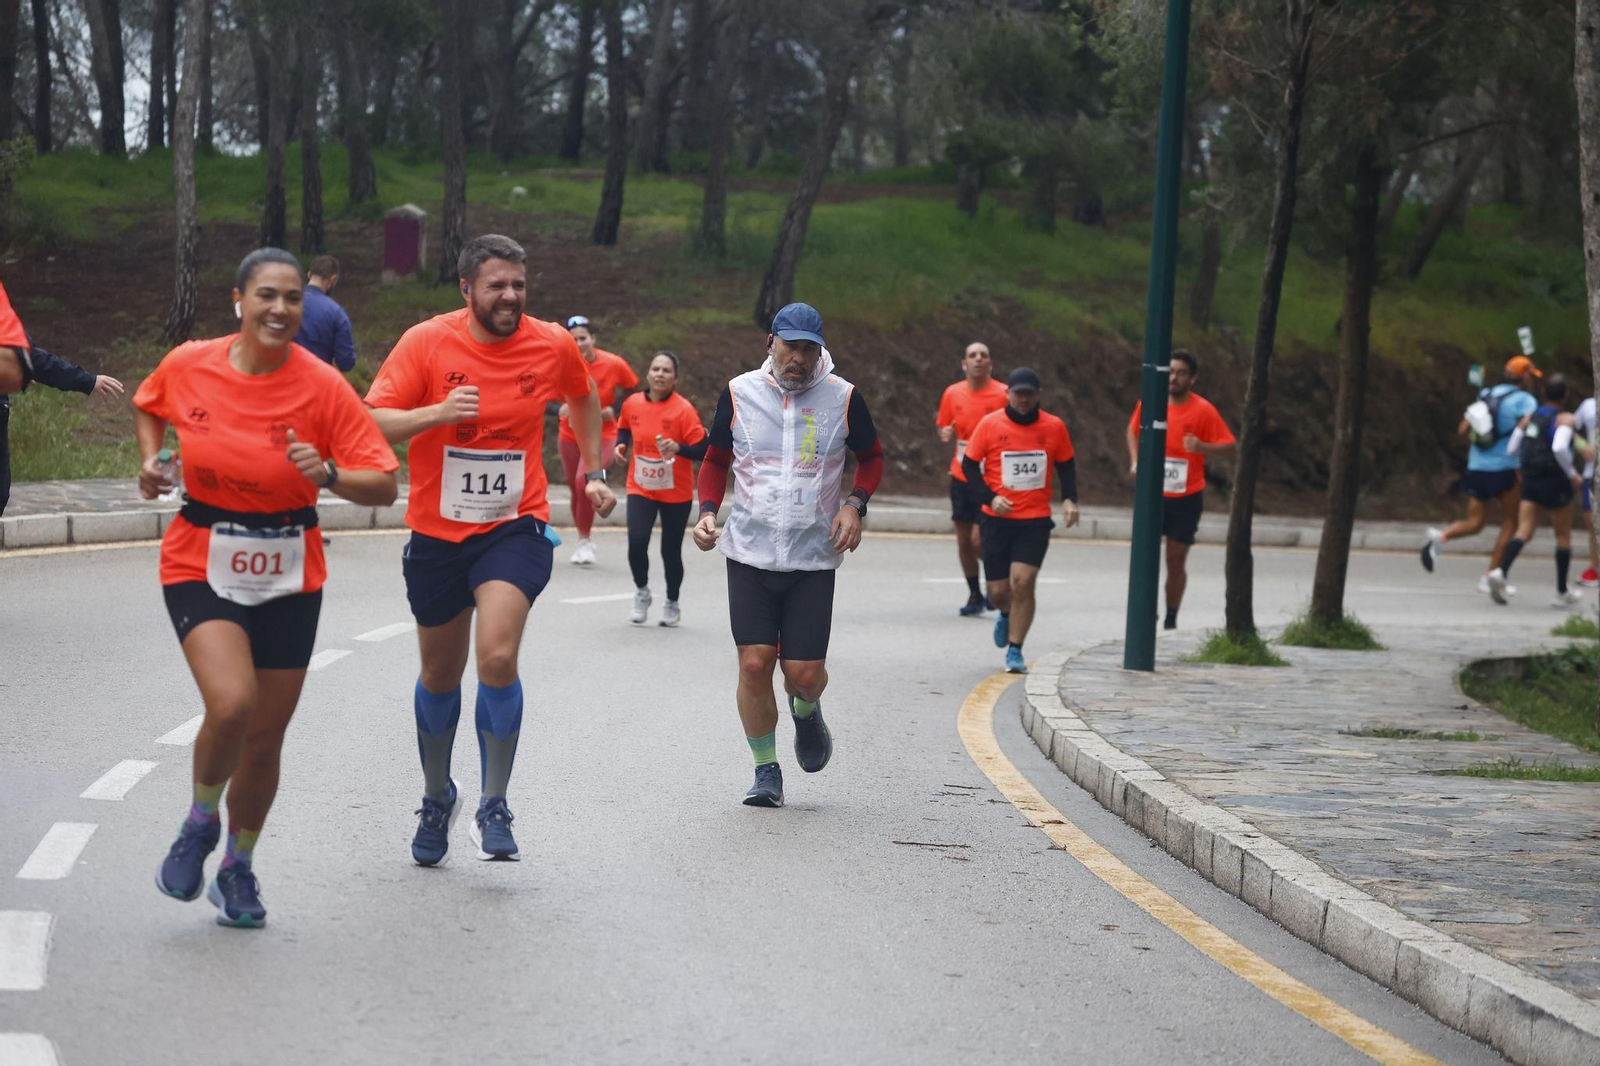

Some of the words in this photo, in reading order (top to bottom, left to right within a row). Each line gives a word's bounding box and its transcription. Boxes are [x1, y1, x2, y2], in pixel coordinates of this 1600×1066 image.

[642, 467, 665, 478] 620
[1013, 463, 1037, 475] 344
[461, 472, 507, 495] 114
[231, 551, 283, 575] 601
